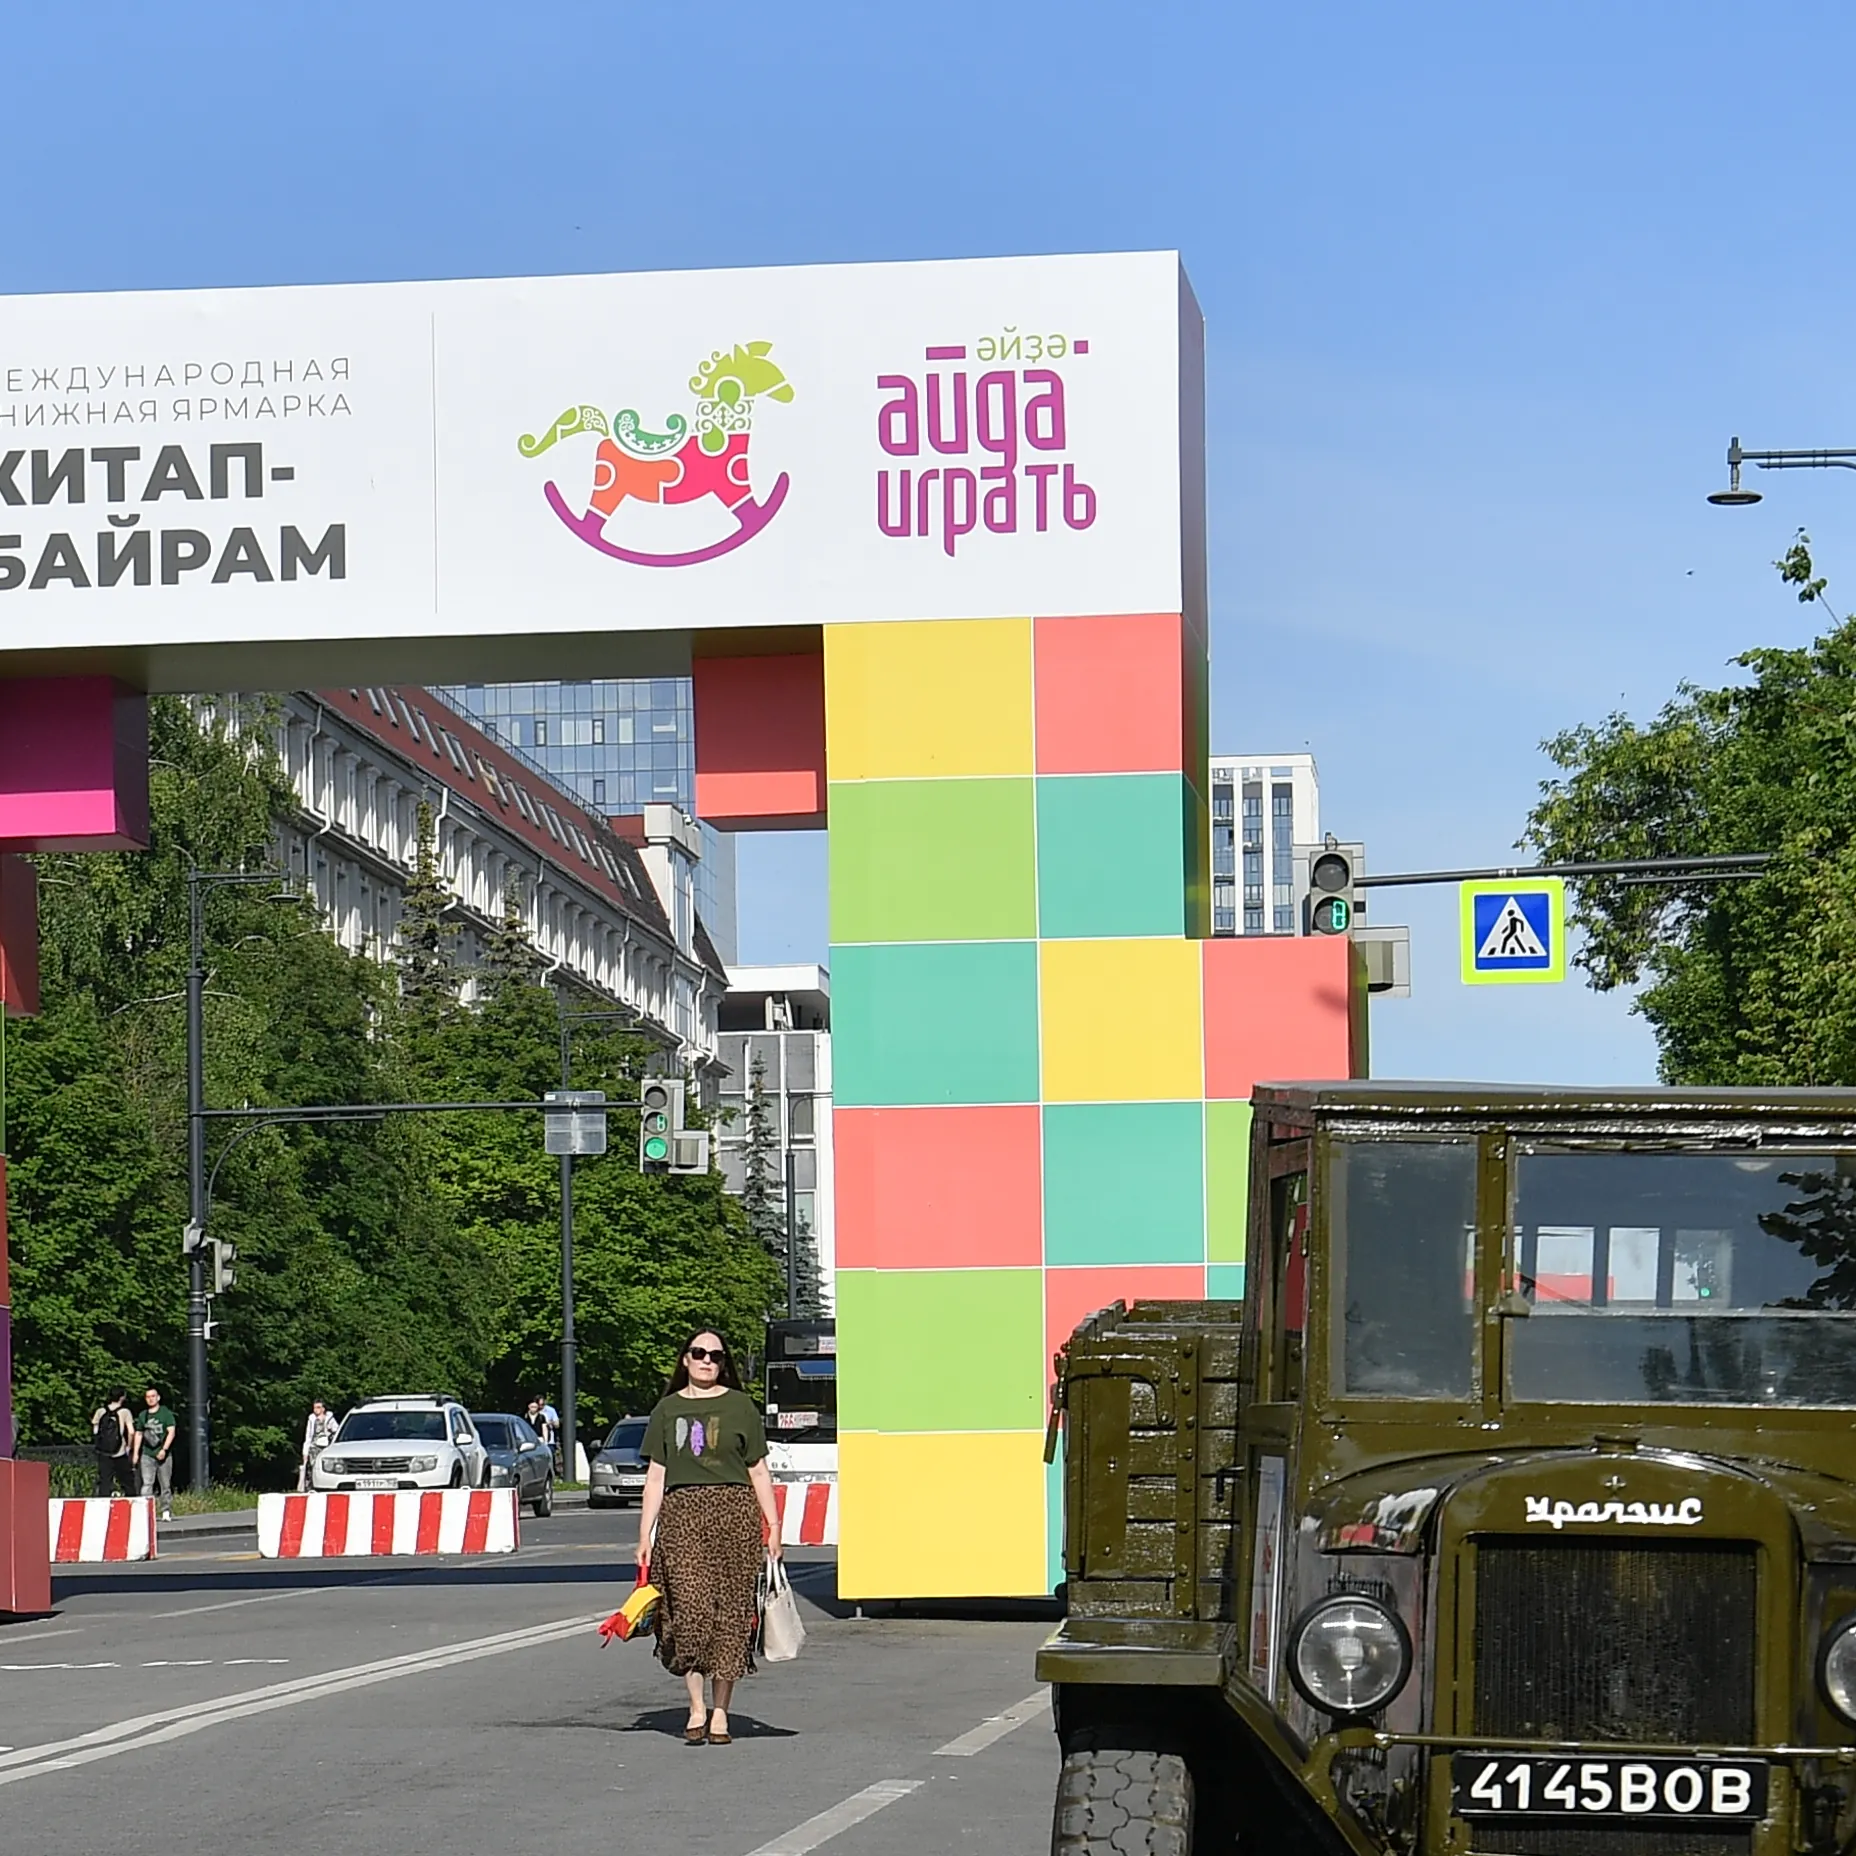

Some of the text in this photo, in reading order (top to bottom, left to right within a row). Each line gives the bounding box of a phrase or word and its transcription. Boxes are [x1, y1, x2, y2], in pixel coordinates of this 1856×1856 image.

[173, 393, 352, 423] ЯРМАРКА
[877, 463, 1097, 557] играть
[1469, 1761, 1752, 1814] 4145ВОВ
